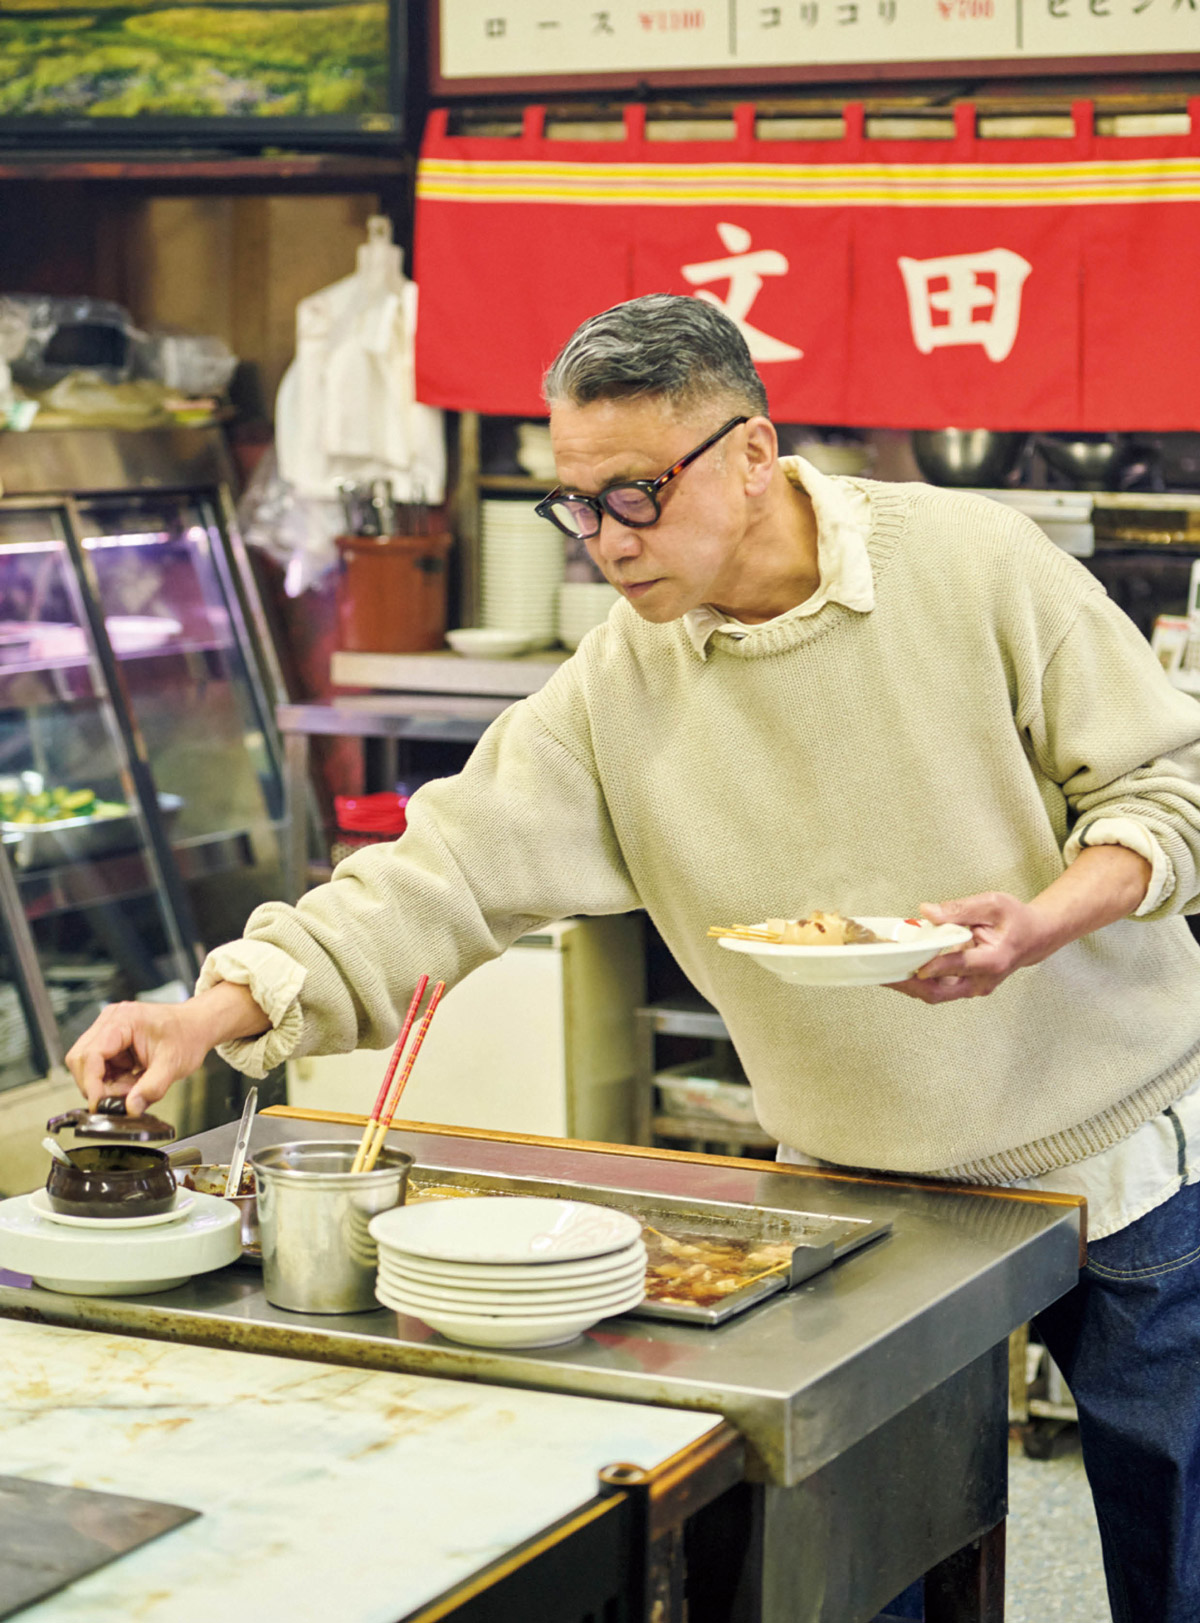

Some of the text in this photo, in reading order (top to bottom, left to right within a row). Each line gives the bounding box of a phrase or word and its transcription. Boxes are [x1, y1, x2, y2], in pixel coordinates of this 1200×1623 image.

[485, 10, 615, 38] ロース
[760, 0, 897, 29] コリコリ
